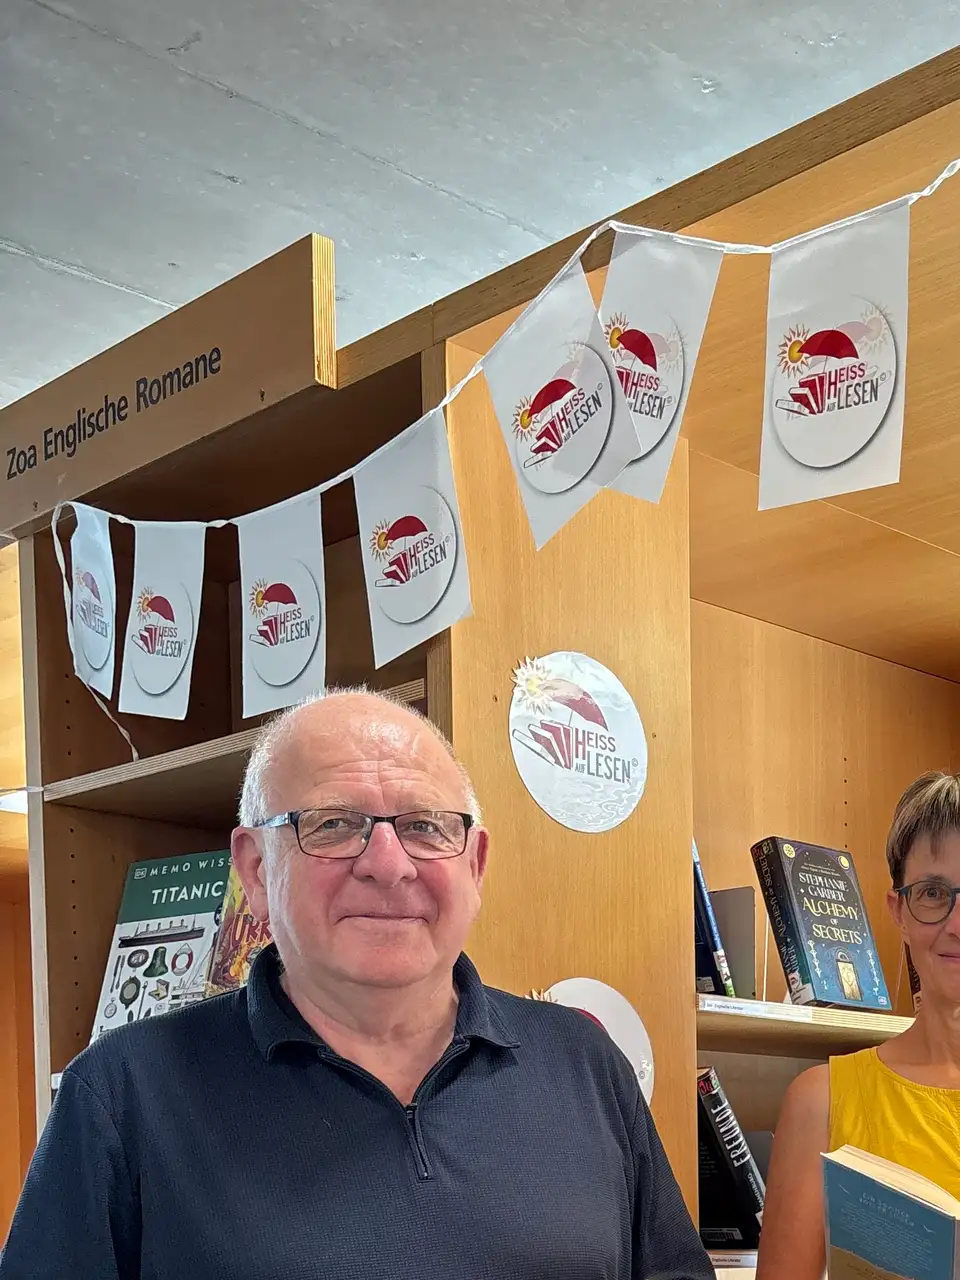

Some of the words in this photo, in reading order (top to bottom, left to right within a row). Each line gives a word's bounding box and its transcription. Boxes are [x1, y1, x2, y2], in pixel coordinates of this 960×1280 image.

[629, 369, 660, 400] HEISS
[827, 362, 866, 400] HEISS
[6, 444, 37, 480] Zoa
[43, 394, 129, 461] Englische
[135, 347, 221, 413] Romane
[556, 388, 586, 434] HEISS
[408, 533, 435, 570] HEISS
[279, 608, 302, 635] HEISS
[575, 728, 616, 761] HEISS
[149, 862, 191, 876] MEMO
[198, 856, 233, 869] WISS
[151, 881, 224, 905] TITANIC
[799, 872, 848, 892] STEPHANIE
[808, 885, 846, 902] GARBER
[803, 897, 858, 920] ALCHEMY
[812, 924, 862, 944] SECRETS
[710, 1099, 751, 1168] FREUNDE
